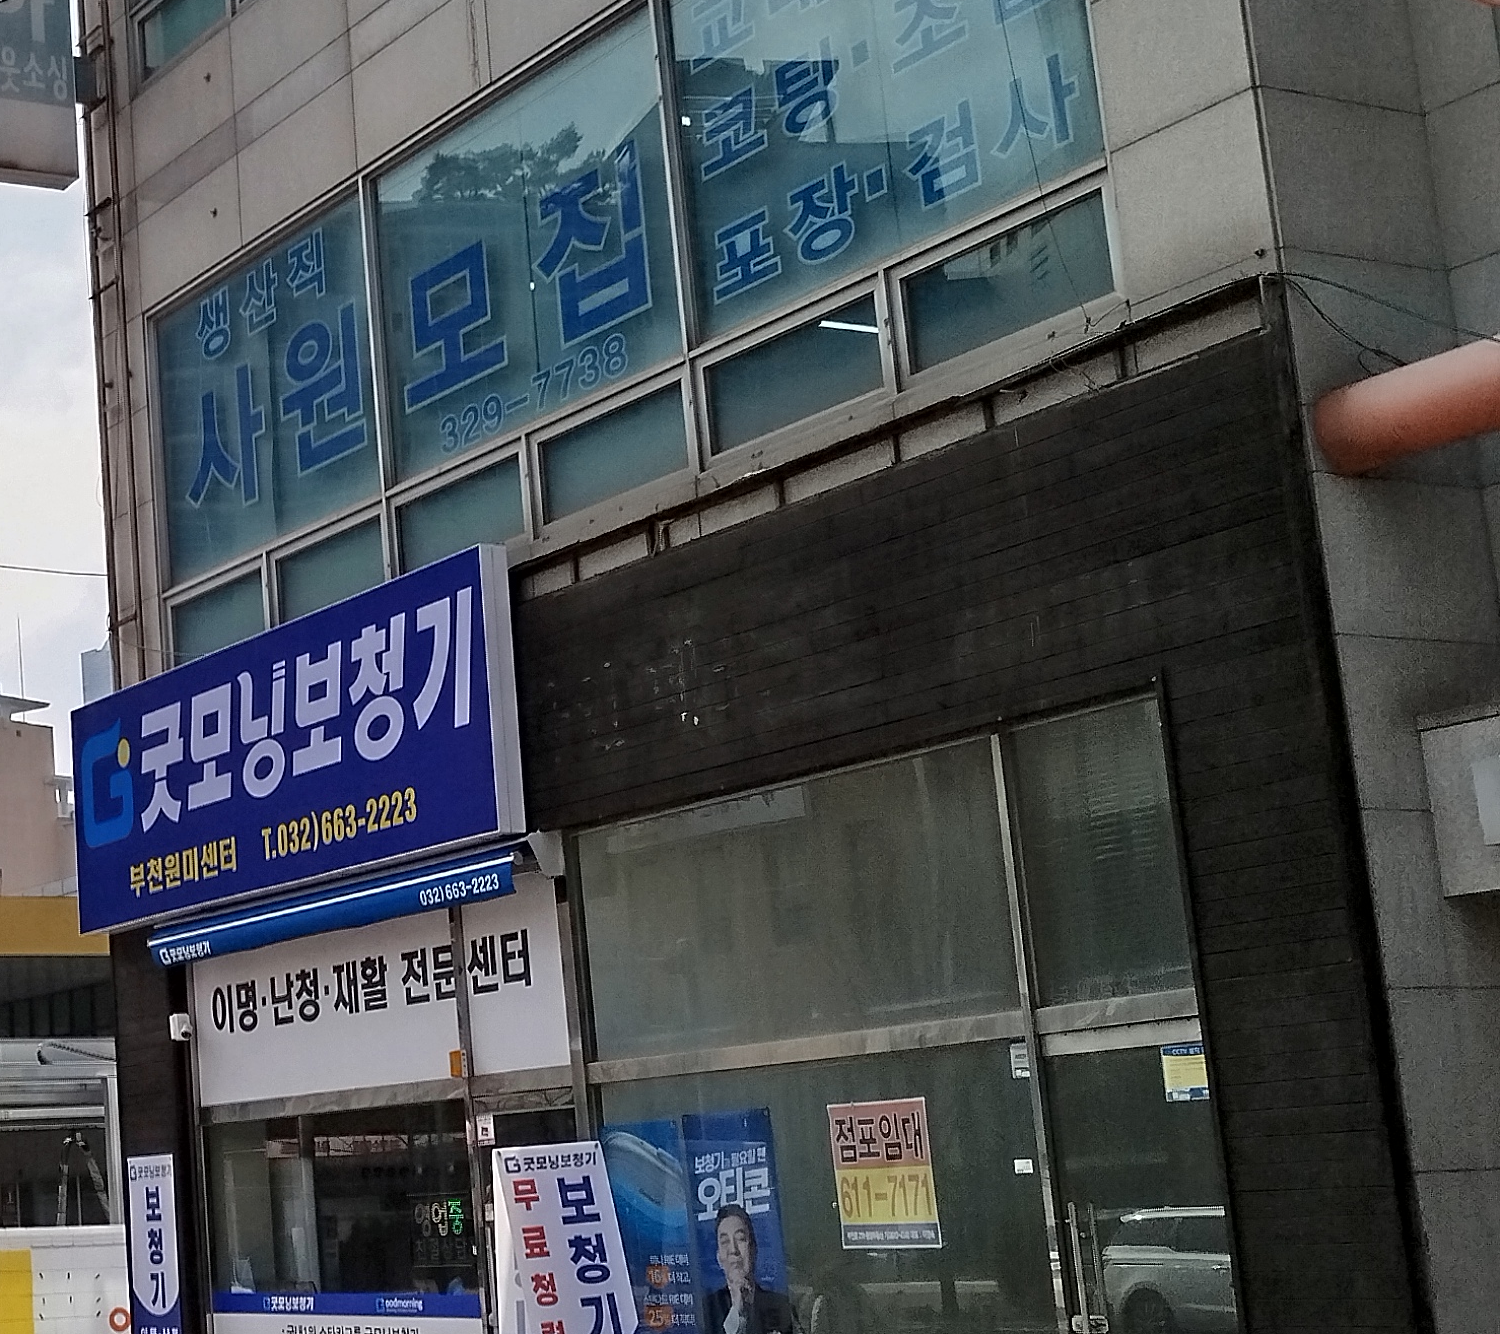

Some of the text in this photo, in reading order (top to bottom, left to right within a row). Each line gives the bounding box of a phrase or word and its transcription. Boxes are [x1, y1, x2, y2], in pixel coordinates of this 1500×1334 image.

[712, 56, 1081, 307] 포장·검사
[196, 226, 327, 362] 생산직
[438, 333, 630, 455] 329-7738
[141, 586, 473, 833] 굿모닝보청기
[129, 785, 419, 900] 부천원미센터 T.032)663-2223
[418, 872, 501, 909] 032)663-2223
[211, 955, 391, 1036] 이명·난청·재활
[523, 1151, 598, 1173] 굿모닝보청기
[834, 1111, 924, 1163] 점포임대
[414, 1198, 465, 1237] 영업중
[697, 1166, 771, 1222] 오티콘
[840, 1173, 933, 1219] 611-7171
[144, 1185, 168, 1309] 보청기
